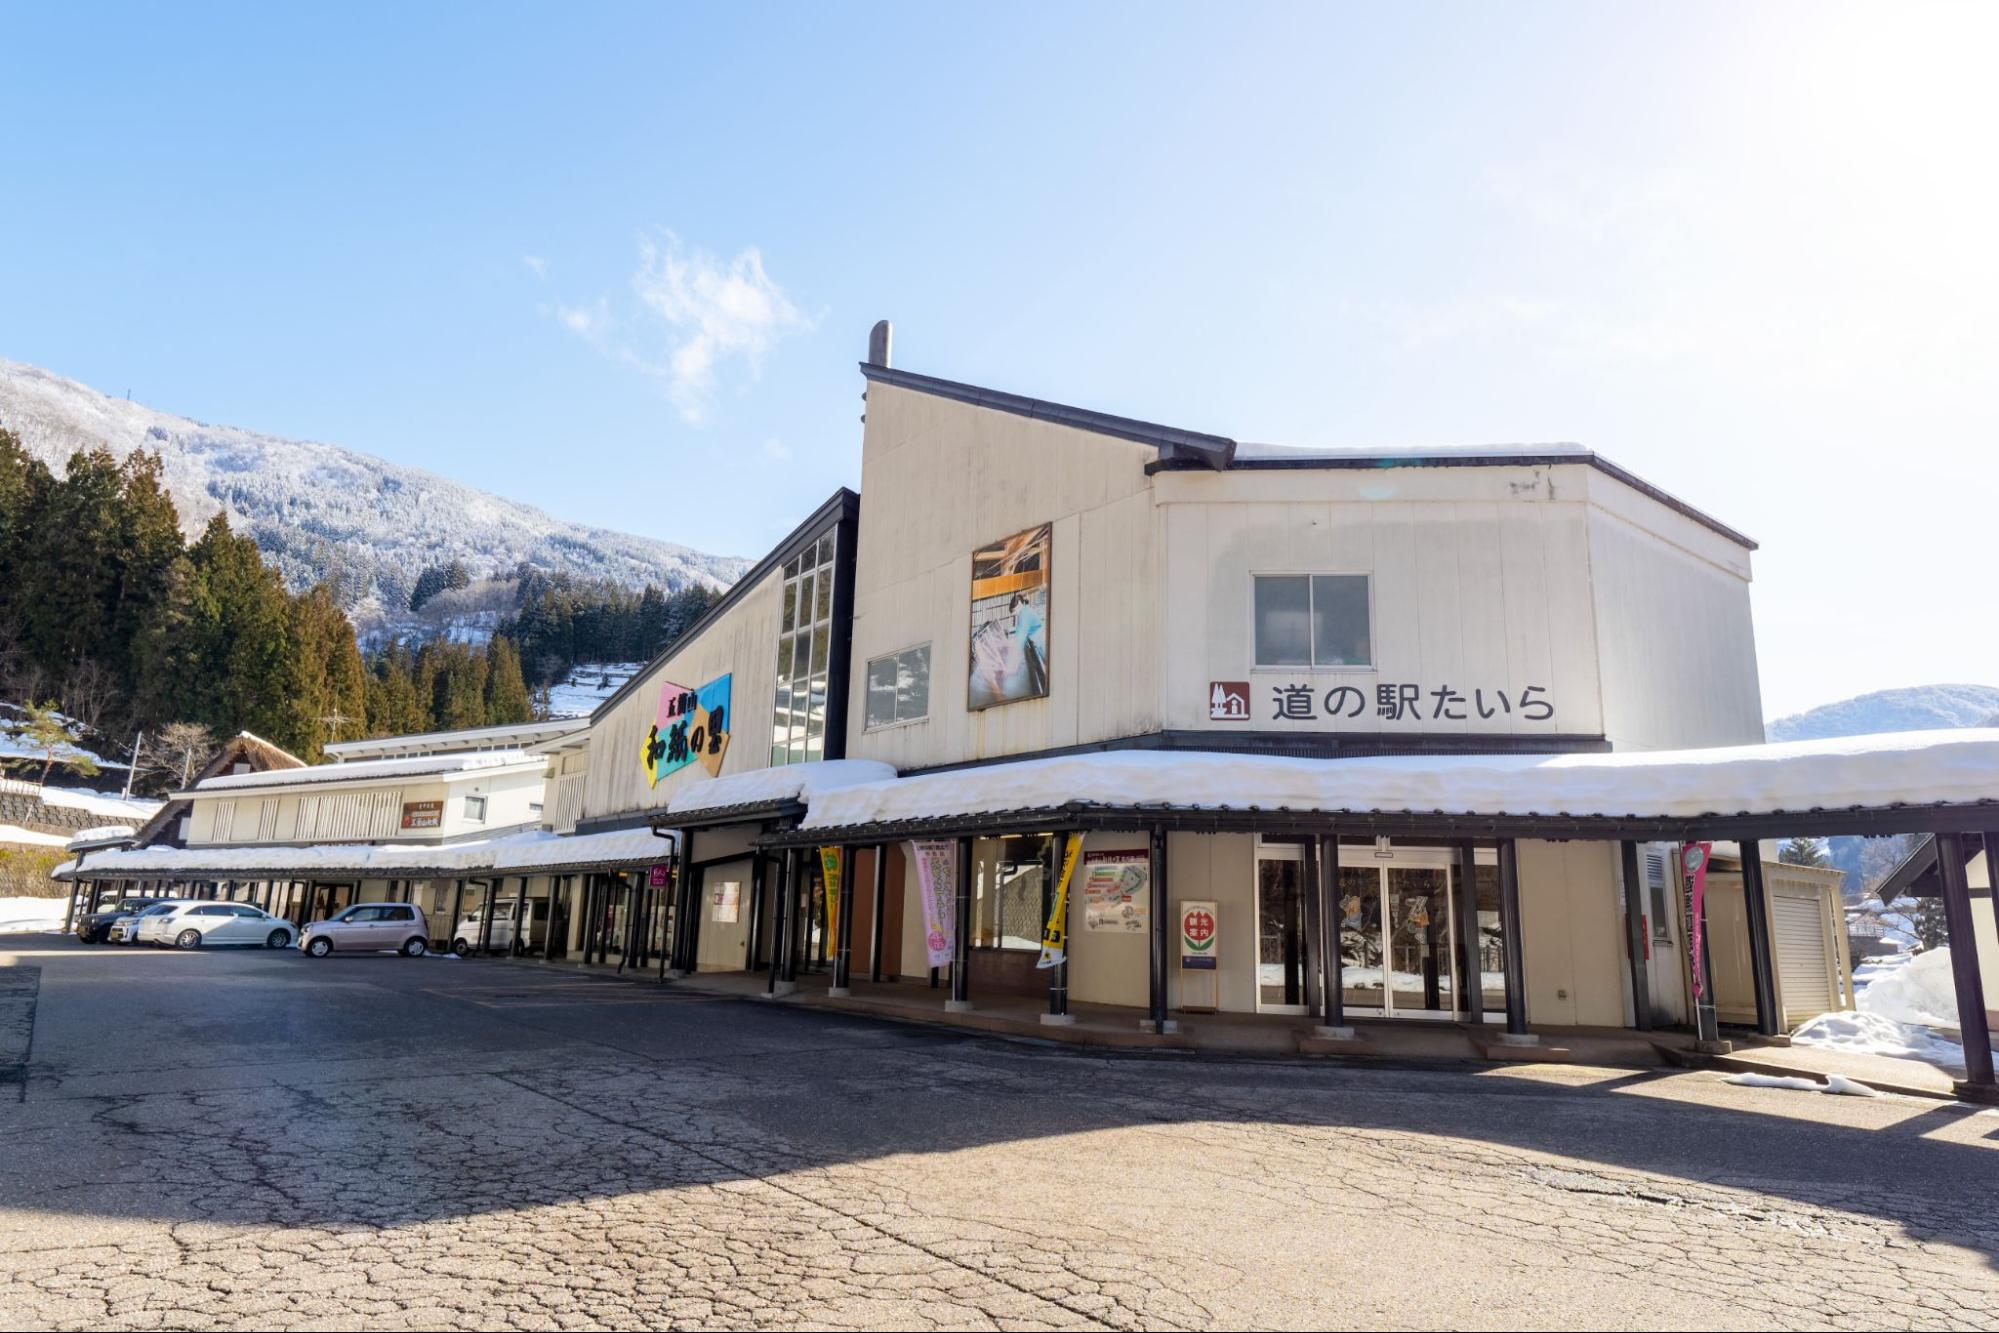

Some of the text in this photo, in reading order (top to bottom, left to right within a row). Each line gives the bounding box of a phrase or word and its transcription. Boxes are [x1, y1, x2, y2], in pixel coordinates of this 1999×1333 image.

[1272, 684, 1555, 720] 道の駅たいら
[647, 706, 724, 768] 和紙の里
